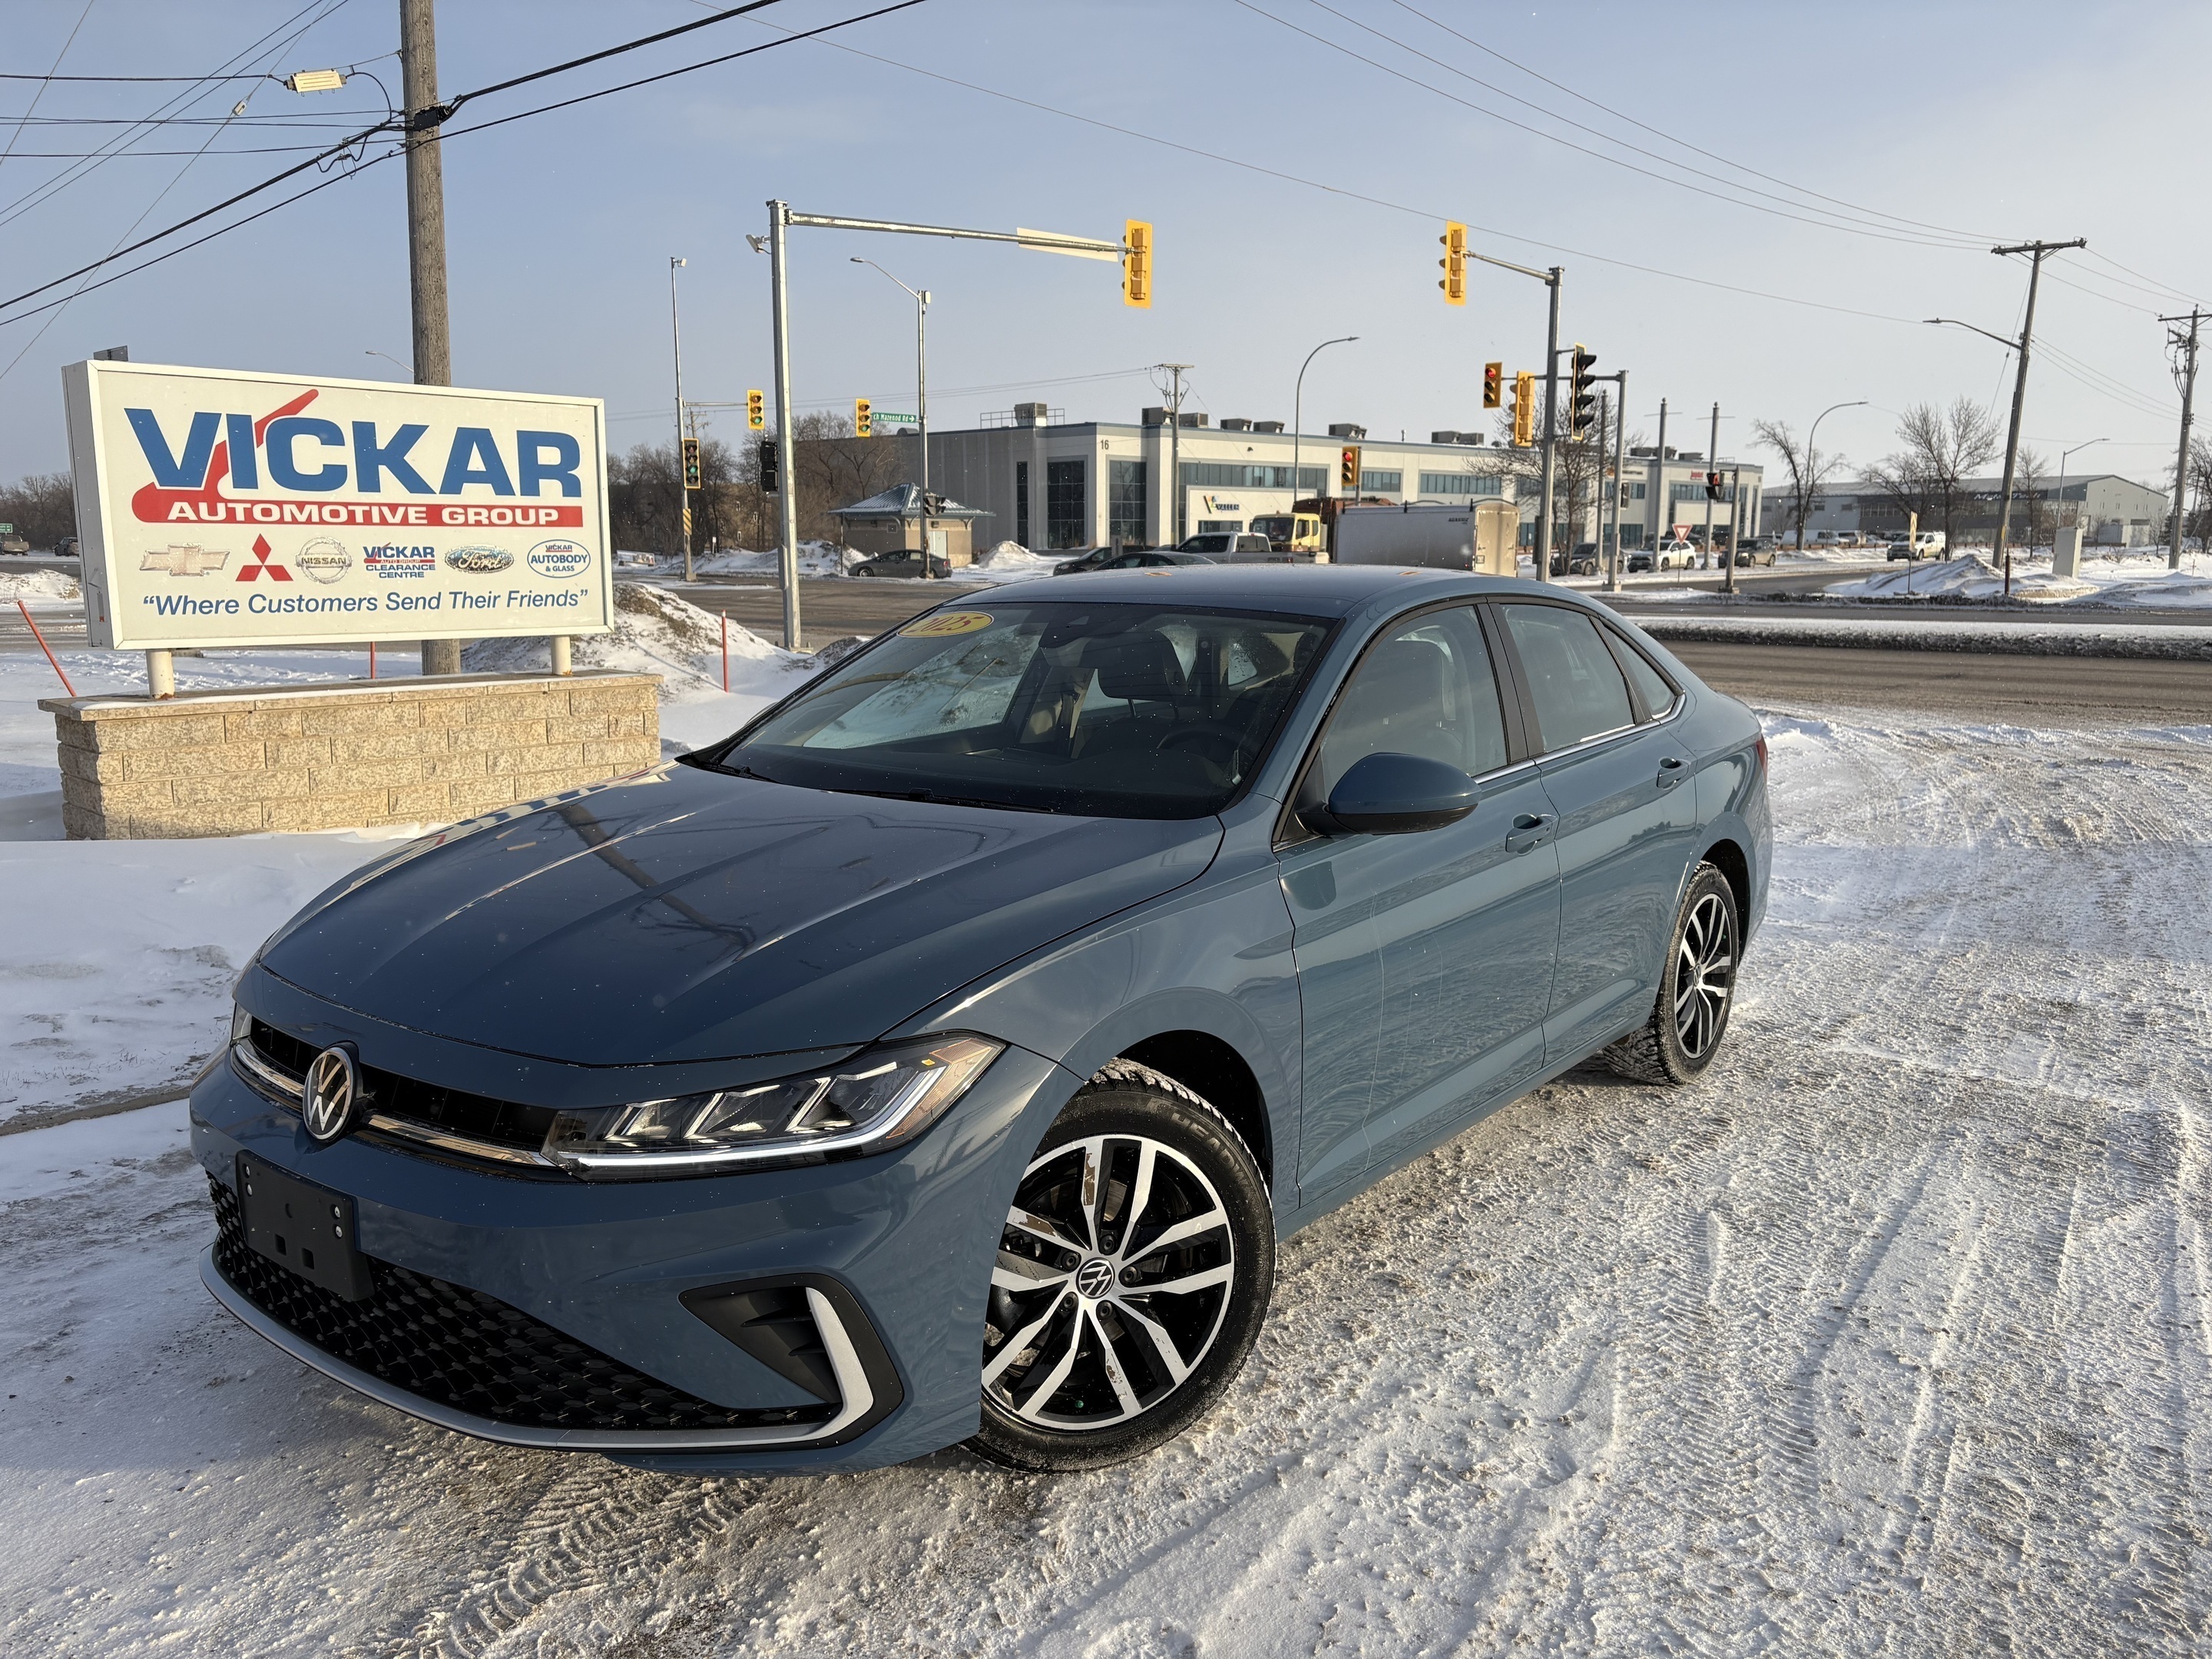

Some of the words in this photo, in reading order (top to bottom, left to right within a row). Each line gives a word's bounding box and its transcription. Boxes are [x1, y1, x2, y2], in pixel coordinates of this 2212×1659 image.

[124, 408, 581, 498] VICKAR
[1101, 439, 1109, 450] 16
[167, 502, 428, 524] AUTOMOTIVE
[442, 507, 559, 525] GROUP
[363, 546, 435, 558] VICKAR
[458, 549, 502, 569] Ford
[531, 555, 588, 564] AUTOBODY
[301, 557, 347, 565] NISSAN
[143, 594, 240, 615] “Where
[248, 594, 378, 614] Customers
[386, 591, 442, 611] Send
[449, 591, 501, 609] Their
[506, 589, 588, 608] Friends”
[906, 616, 985, 633] 2025
